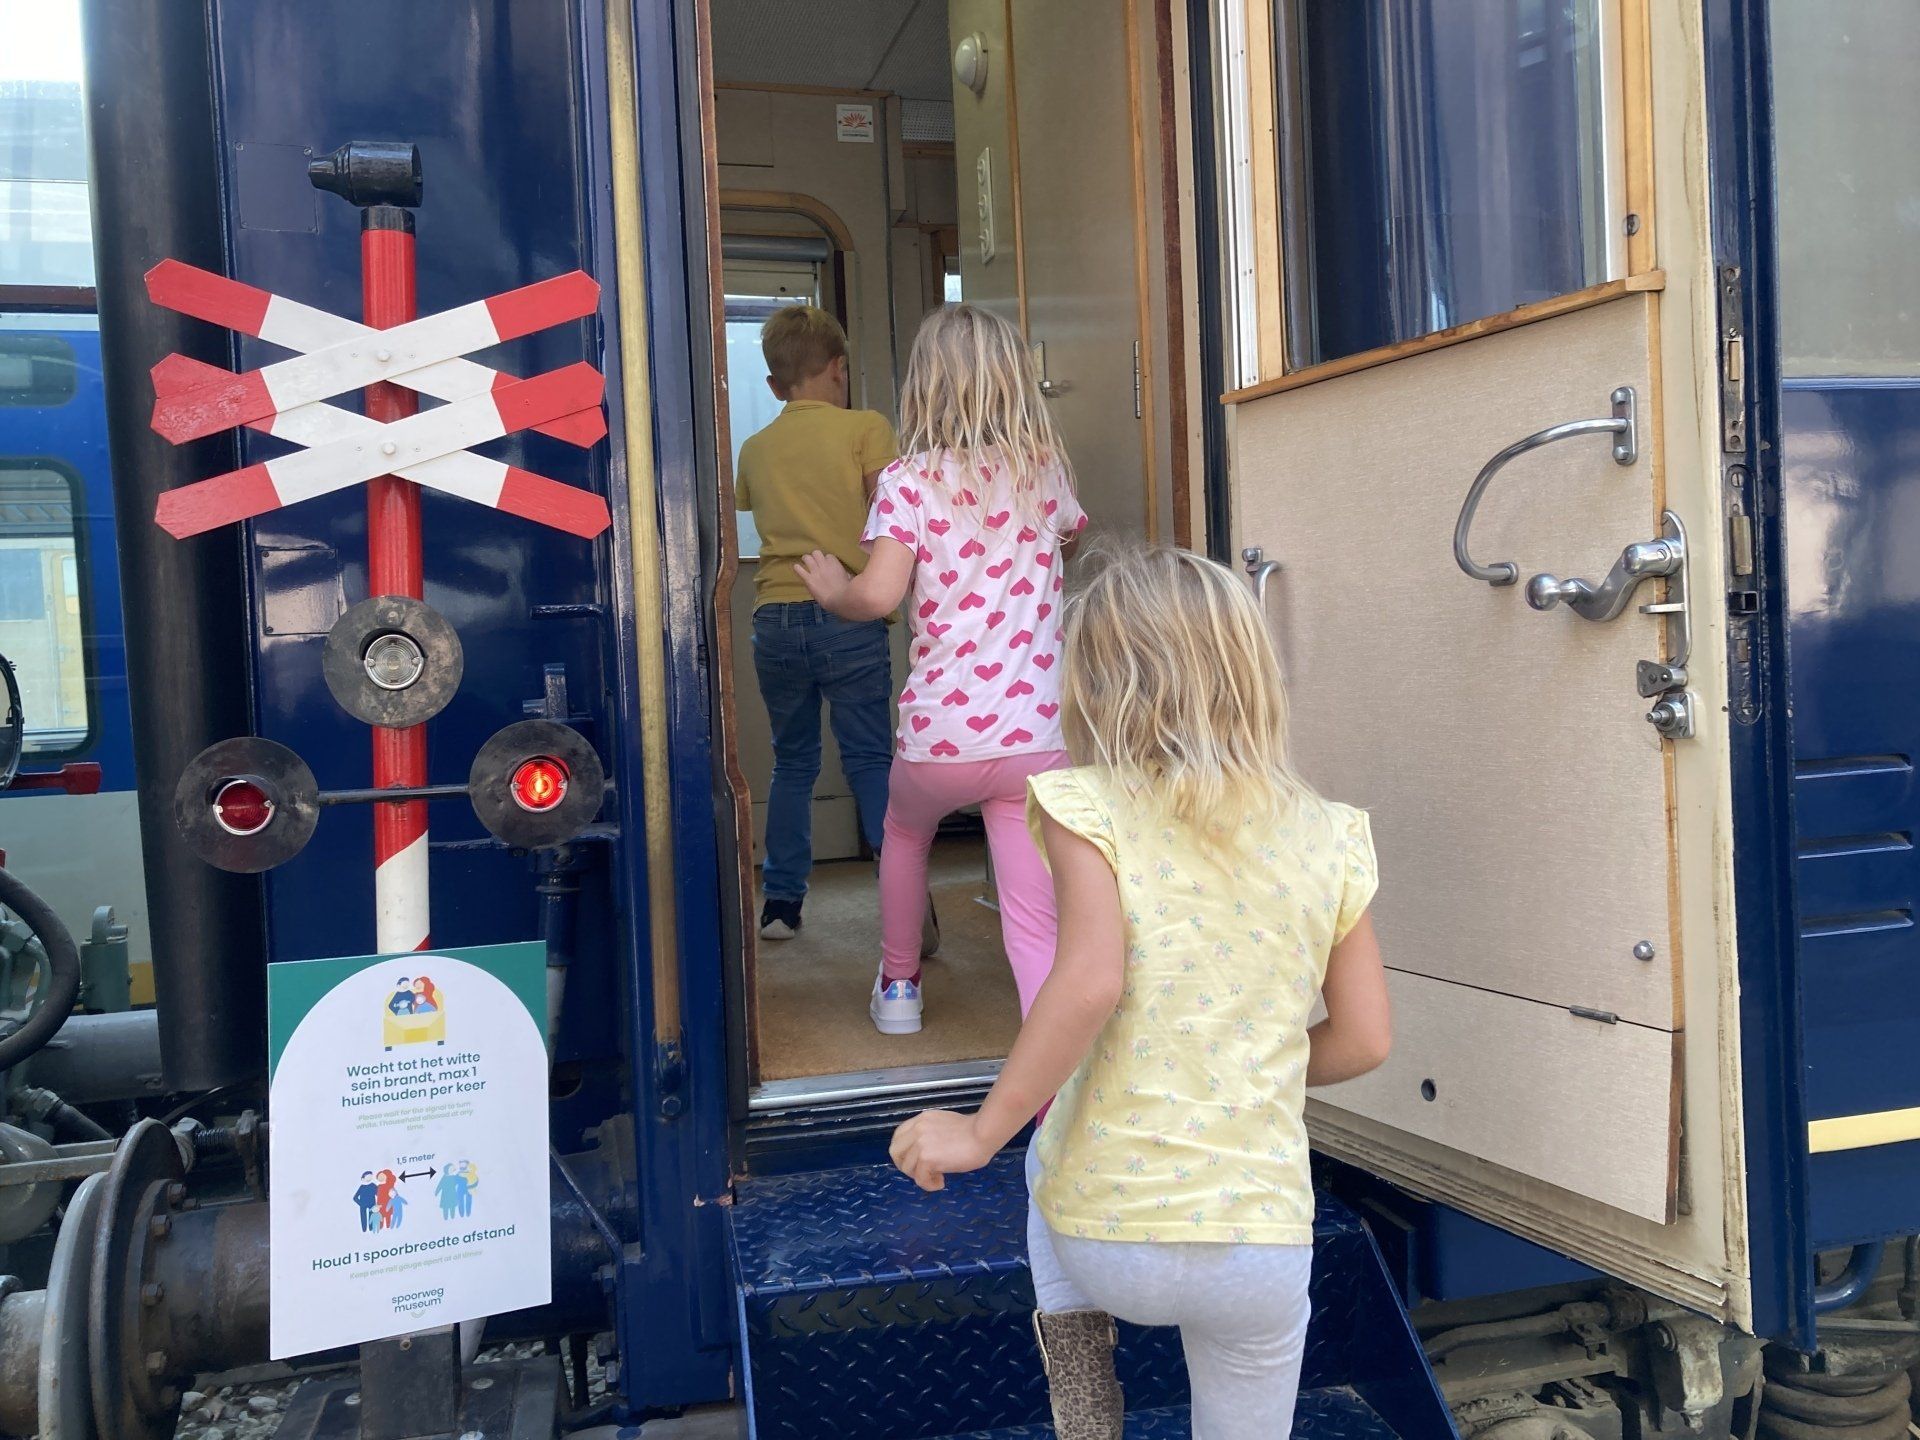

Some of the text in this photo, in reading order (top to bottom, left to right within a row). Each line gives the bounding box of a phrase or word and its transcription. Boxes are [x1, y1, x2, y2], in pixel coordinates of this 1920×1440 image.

[347, 1053, 481, 1077] Wacht tot het witte
[351, 1067, 477, 1091] sein brandt, max 1
[342, 1080, 486, 1107] huishouden per keer
[409, 1153, 435, 1163] meter
[312, 1224, 515, 1270] Houd 1 spoorbreedte afstand
[391, 1287, 444, 1305] spoorweg
[395, 1297, 441, 1312] museum
